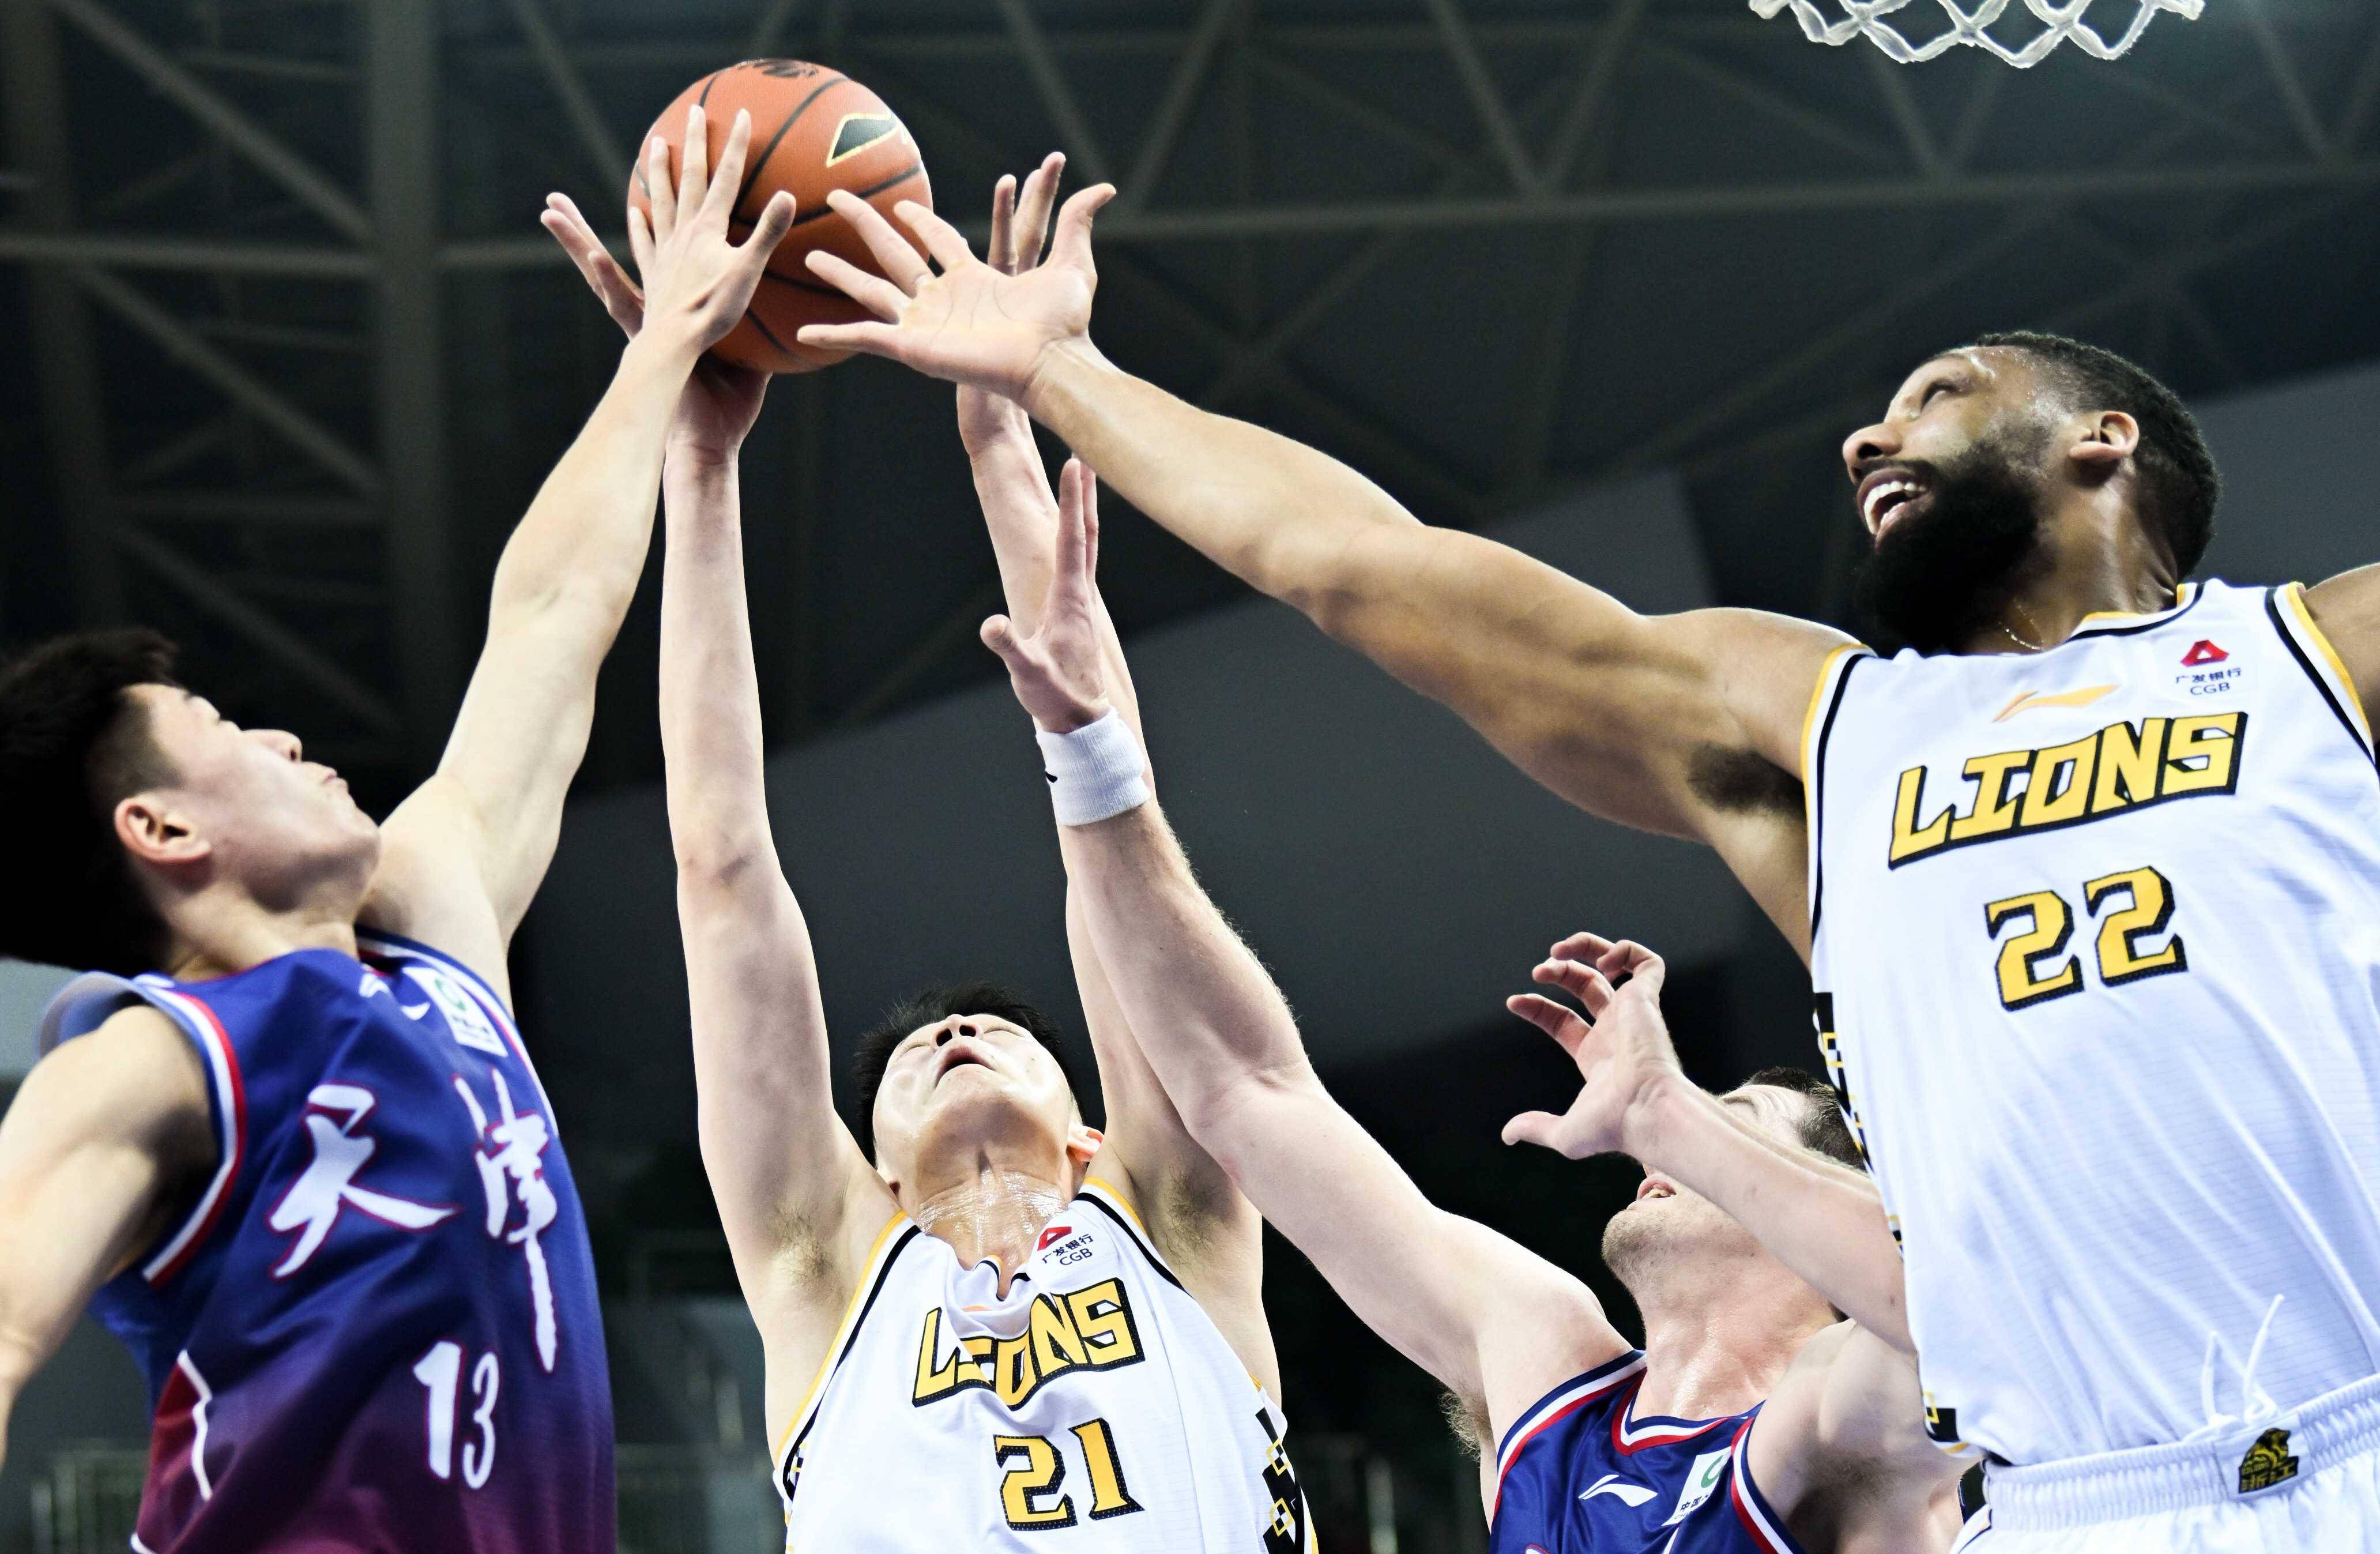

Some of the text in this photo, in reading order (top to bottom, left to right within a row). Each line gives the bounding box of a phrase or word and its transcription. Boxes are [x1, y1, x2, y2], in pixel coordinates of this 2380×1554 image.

[2176, 667, 2241, 684] 广发银行
[2190, 682, 2230, 695] CGB
[1888, 712, 2248, 870] LIONS
[1984, 866, 2188, 1012] 22
[1042, 1233, 1094, 1264] 广发银行
[1060, 1248, 1093, 1265] CGB
[413, 1340, 500, 1488] 13
[994, 1417, 1144, 1531] 21
